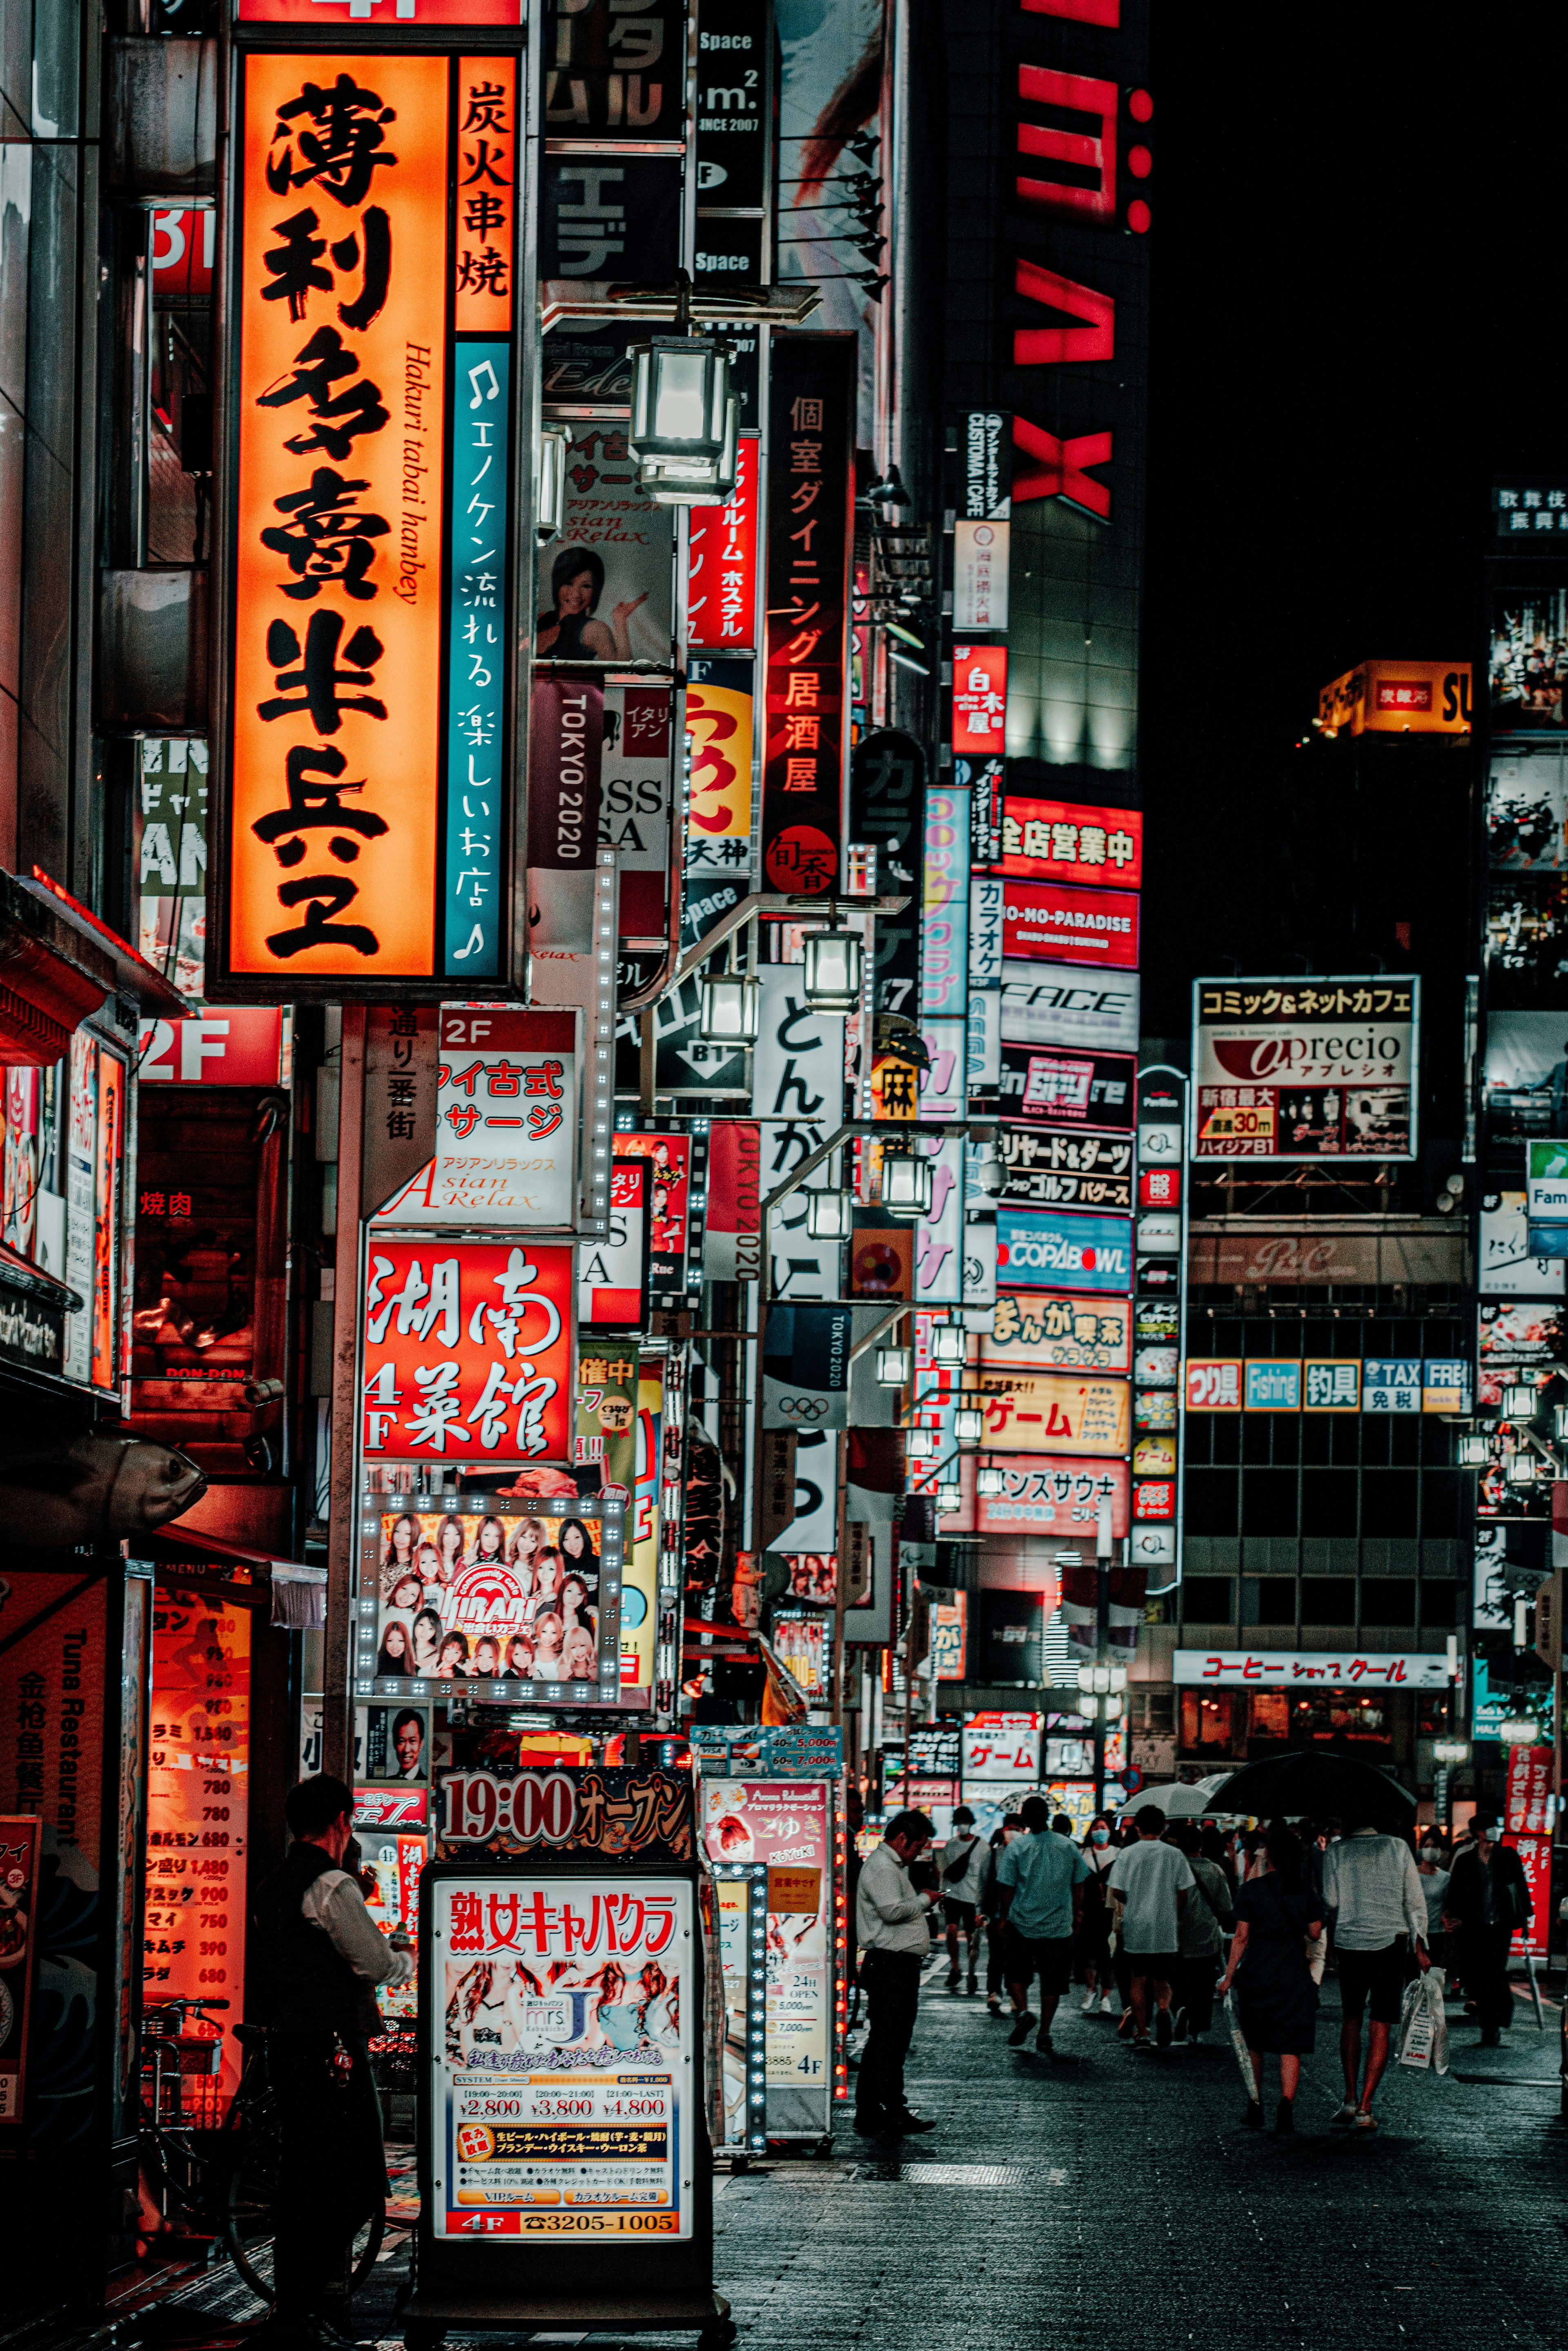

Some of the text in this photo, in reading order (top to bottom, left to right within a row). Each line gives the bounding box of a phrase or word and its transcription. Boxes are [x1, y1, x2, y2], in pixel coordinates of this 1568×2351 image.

[700, 32, 752, 50] Space
[699, 118, 759, 131] INCE 2007
[695, 252, 750, 271] Space
[393, 341, 430, 605] Hakuri tabai hanbey
[720, 571, 744, 637] ホステル
[783, 397, 824, 792] 個室ダイニング居酒屋
[557, 695, 586, 858] TOKYO 2020
[1003, 816, 1134, 868] 全店営業中
[978, 883, 999, 974] カラオケ
[1003, 906, 1131, 933] O-MO-PARADISE
[1203, 988, 1411, 1015] コミック&ネットカフェ
[446, 1020, 492, 1044] 2F
[139, 1019, 229, 1080] 2F
[692, 1044, 725, 1063] B1
[1300, 1064, 1395, 1077] アプレシオ
[1201, 1088, 1275, 1107] 新宿最大
[443, 1104, 563, 1140] サージ
[1000, 1134, 1131, 1174] リヤード&ダーツ
[1199, 1138, 1273, 1155] ハイジアB1
[443, 1157, 557, 1172] アジアンリラックス
[140, 1191, 192, 1216] 焼肉
[443, 1190, 541, 1211] Relax
[735, 1219, 760, 1281] 2020
[368, 1247, 561, 1358] 湖南
[992, 1296, 1123, 1348] まんが喫茶
[829, 1316, 845, 1387] TOKYO 2020
[1052, 1347, 1111, 1369] ゲラゲラ
[166, 1368, 245, 1378] DON-DON
[1383, 1364, 1421, 1385] TAX
[1188, 1365, 1239, 1406] つり具
[1250, 1368, 1297, 1405] Fishing
[1307, 1366, 1358, 1405] 釣具
[1372, 1390, 1412, 1409] 免税
[405, 1361, 558, 1458] 菜館
[985, 1398, 1073, 1438] ゲーム
[1136, 1451, 1173, 1463] ゲーム
[1477, 1530, 1493, 1543] 2F
[462, 1622, 532, 1636] 出会いカフェ
[1203, 1656, 1407, 1682] コーヒー クール
[57, 1628, 87, 1846] Tuna Restaurant
[970, 1745, 1033, 1768] ゲーム
[203, 1780, 231, 1795] 780
[202, 1806, 230, 1822] 780
[442, 1772, 690, 1845] 19:00 オープン
[757, 1815, 822, 1842] こゆき
[202, 1831, 229, 1847] 680
[200, 1887, 228, 1902] 900
[200, 1914, 228, 1929] 750
[449, 1891, 676, 1956] 熟女キャバクラ
[199, 1941, 227, 1957] 390
[198, 1968, 227, 1983] 680
[793, 1976, 817, 1988] 24H
[790, 1990, 819, 1998] OPEN
[797, 2055, 822, 2074] 4F
[454, 2076, 492, 2084] SYSTEM
[460, 2100, 521, 2117] ¥2,800
[531, 2100, 592, 2117] ¥3,800
[603, 2100, 665, 2117] ¥4,800
[461, 2129, 485, 2144] 飲み
[465, 2141, 490, 2157] 放題
[484, 2192, 535, 2202] VIPルーム
[461, 2213, 504, 2231] 4F
[547, 2215, 673, 2230] 3205-1005
